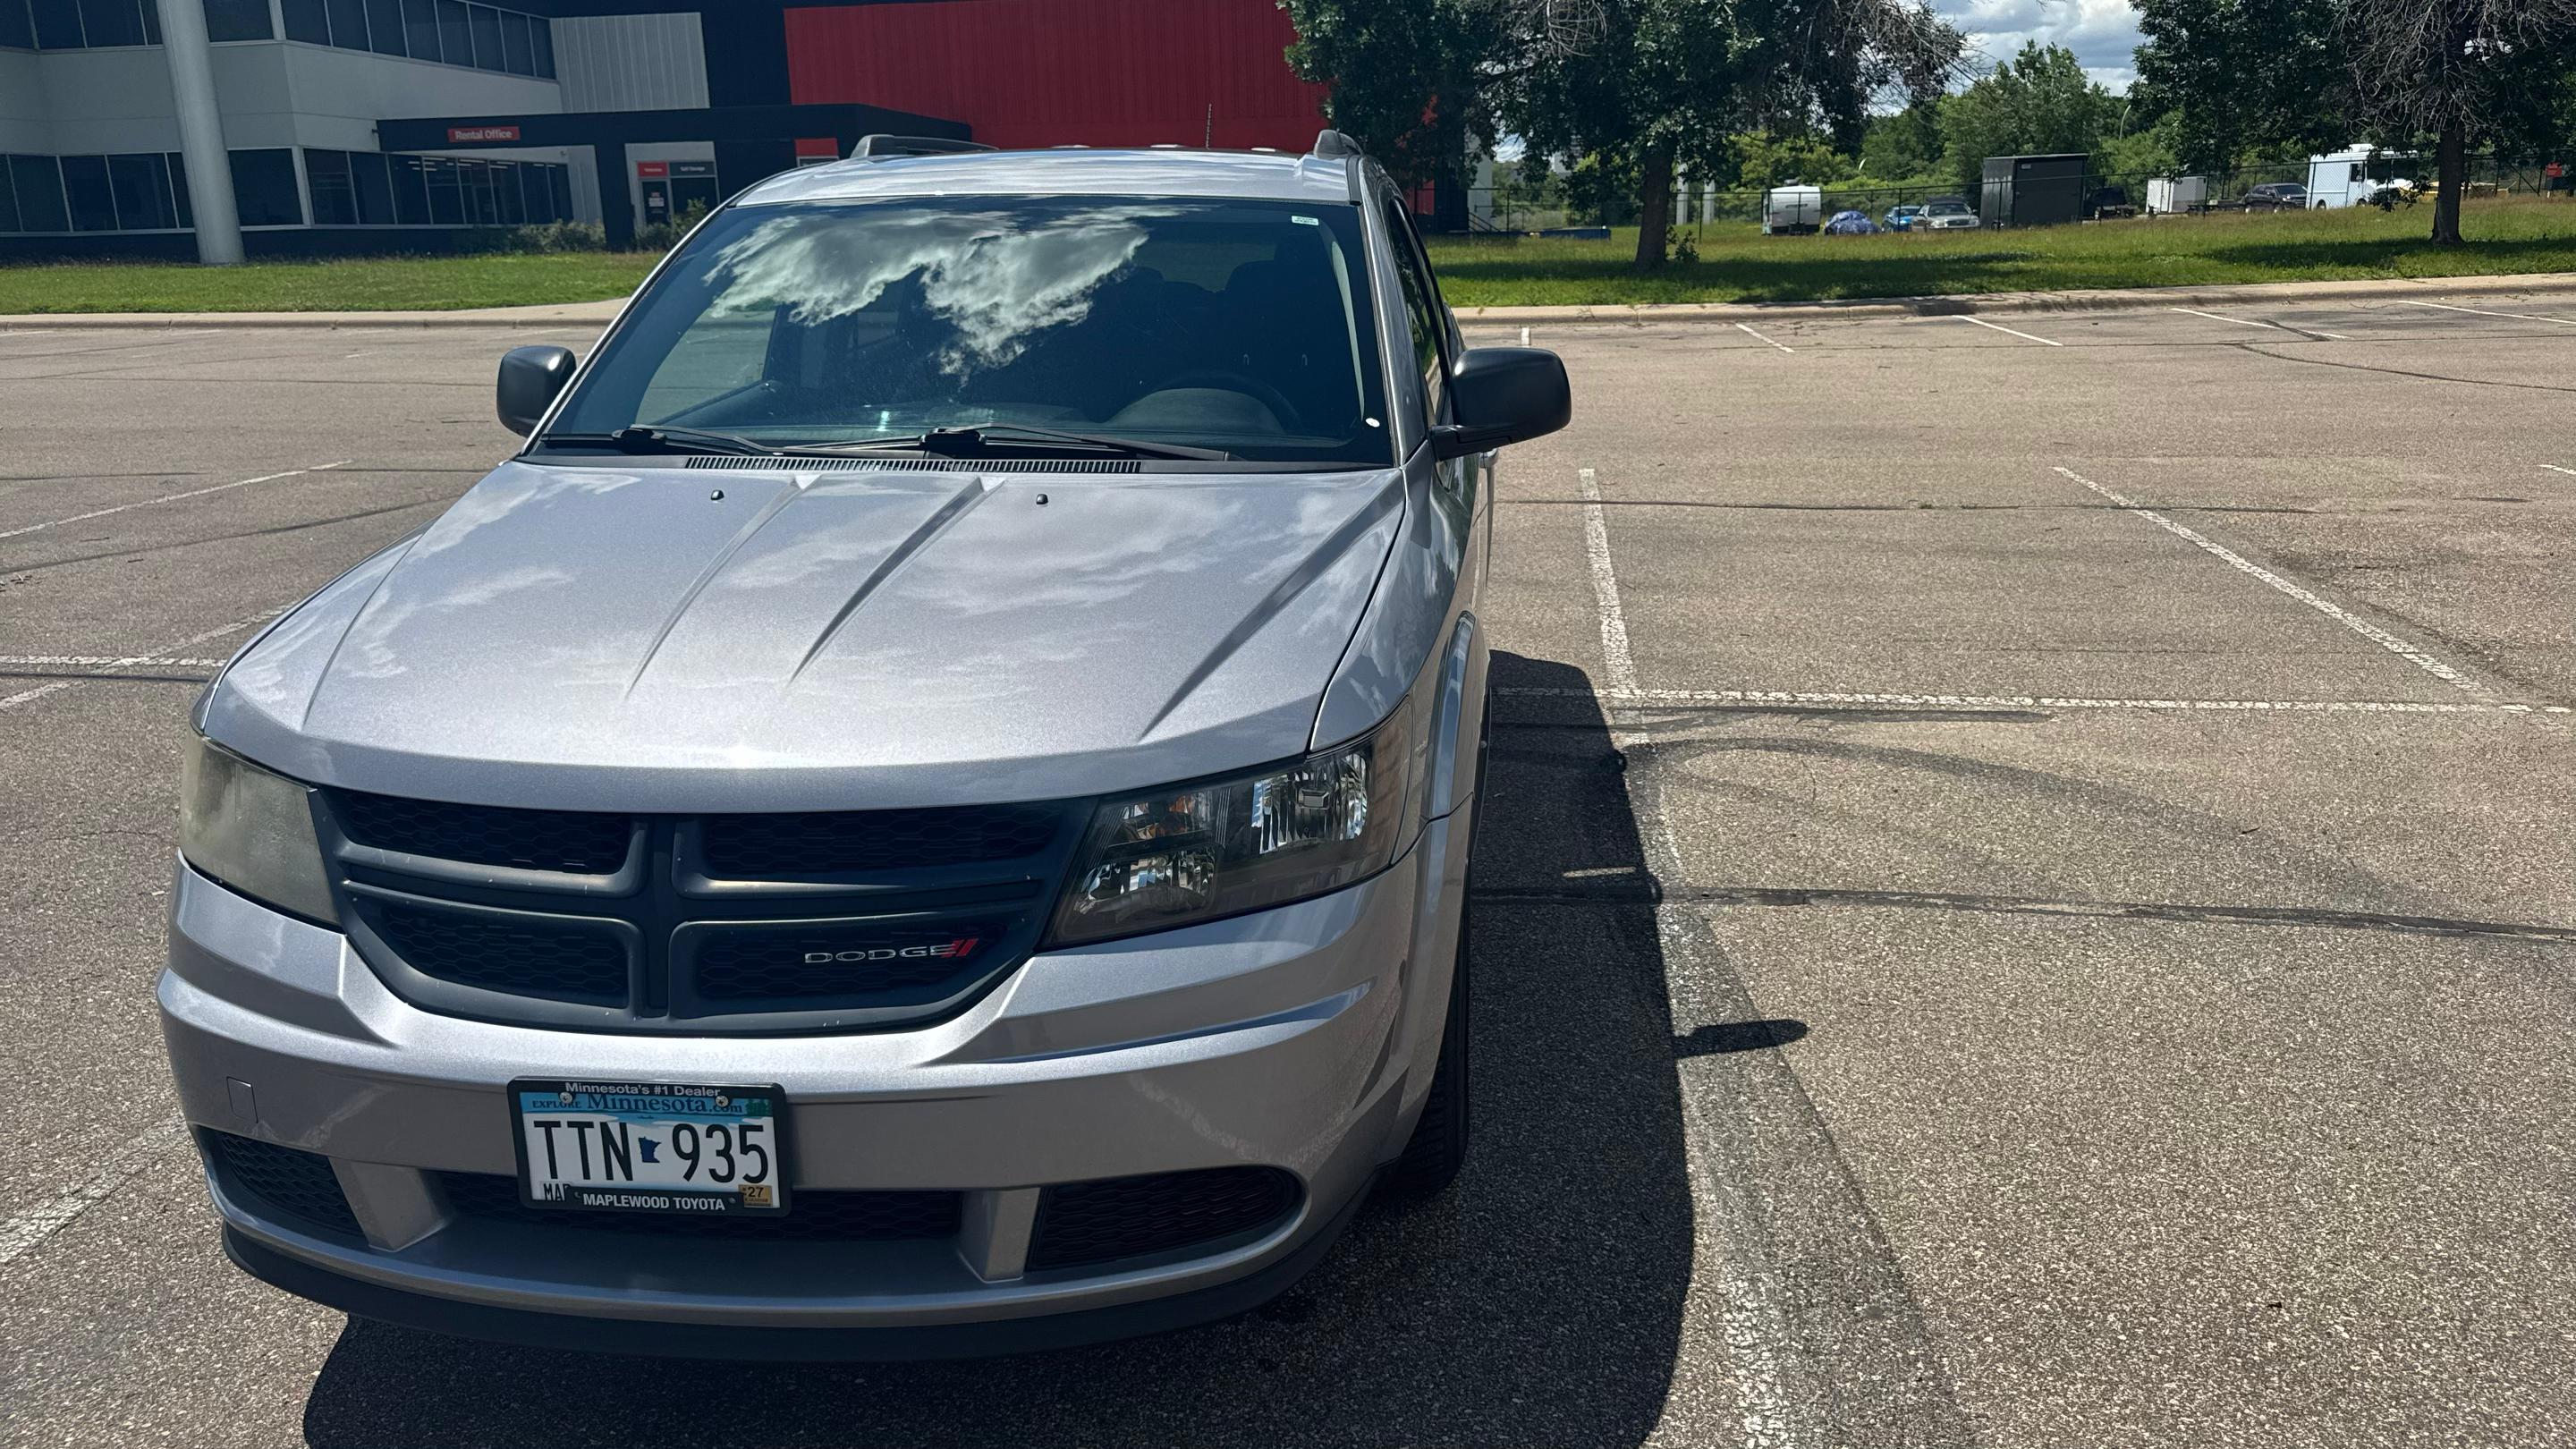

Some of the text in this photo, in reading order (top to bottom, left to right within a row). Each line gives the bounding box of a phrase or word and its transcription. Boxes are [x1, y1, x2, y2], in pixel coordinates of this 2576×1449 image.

[454, 128, 513, 140] Rental Office
[804, 944, 957, 963] DODGE
[564, 1081, 721, 1097] Minnesota's #1 Dealer
[533, 1120, 769, 1184] TTN 935
[748, 1186, 765, 1198] 27
[583, 1192, 726, 1211] MAPLEWOOD TOYOTA
